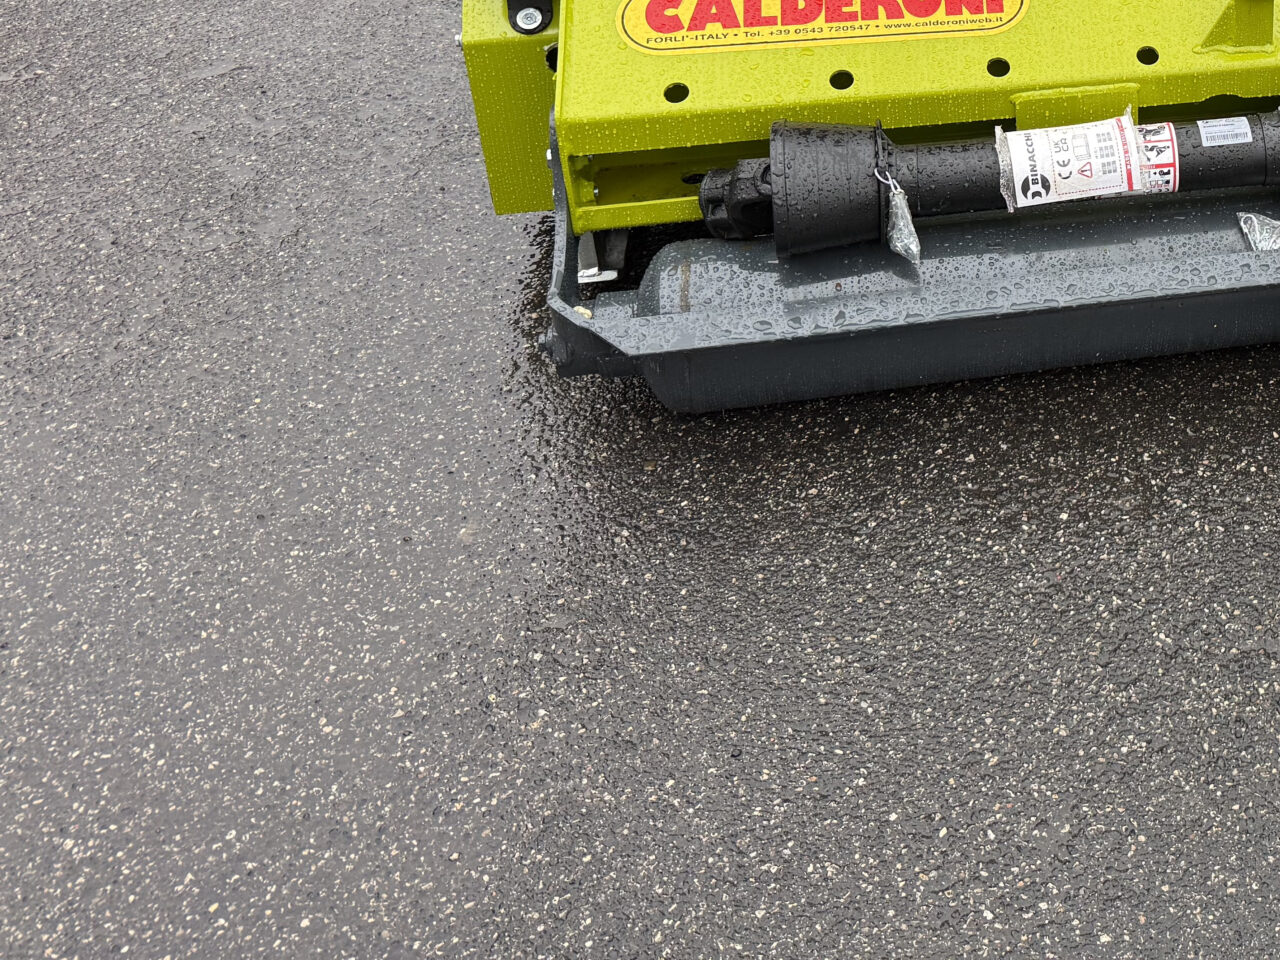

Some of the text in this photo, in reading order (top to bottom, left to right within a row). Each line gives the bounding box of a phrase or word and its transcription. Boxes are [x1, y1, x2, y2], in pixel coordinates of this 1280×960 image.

[743, 30, 765, 38] Tel.
[768, 28, 791, 37] +39
[794, 27, 824, 35] 0543
[827, 24, 871, 33] 720547
[883, 16, 1003, 29] www.calderoniweb.it
[1023, 132, 1040, 186] BINACCHI
